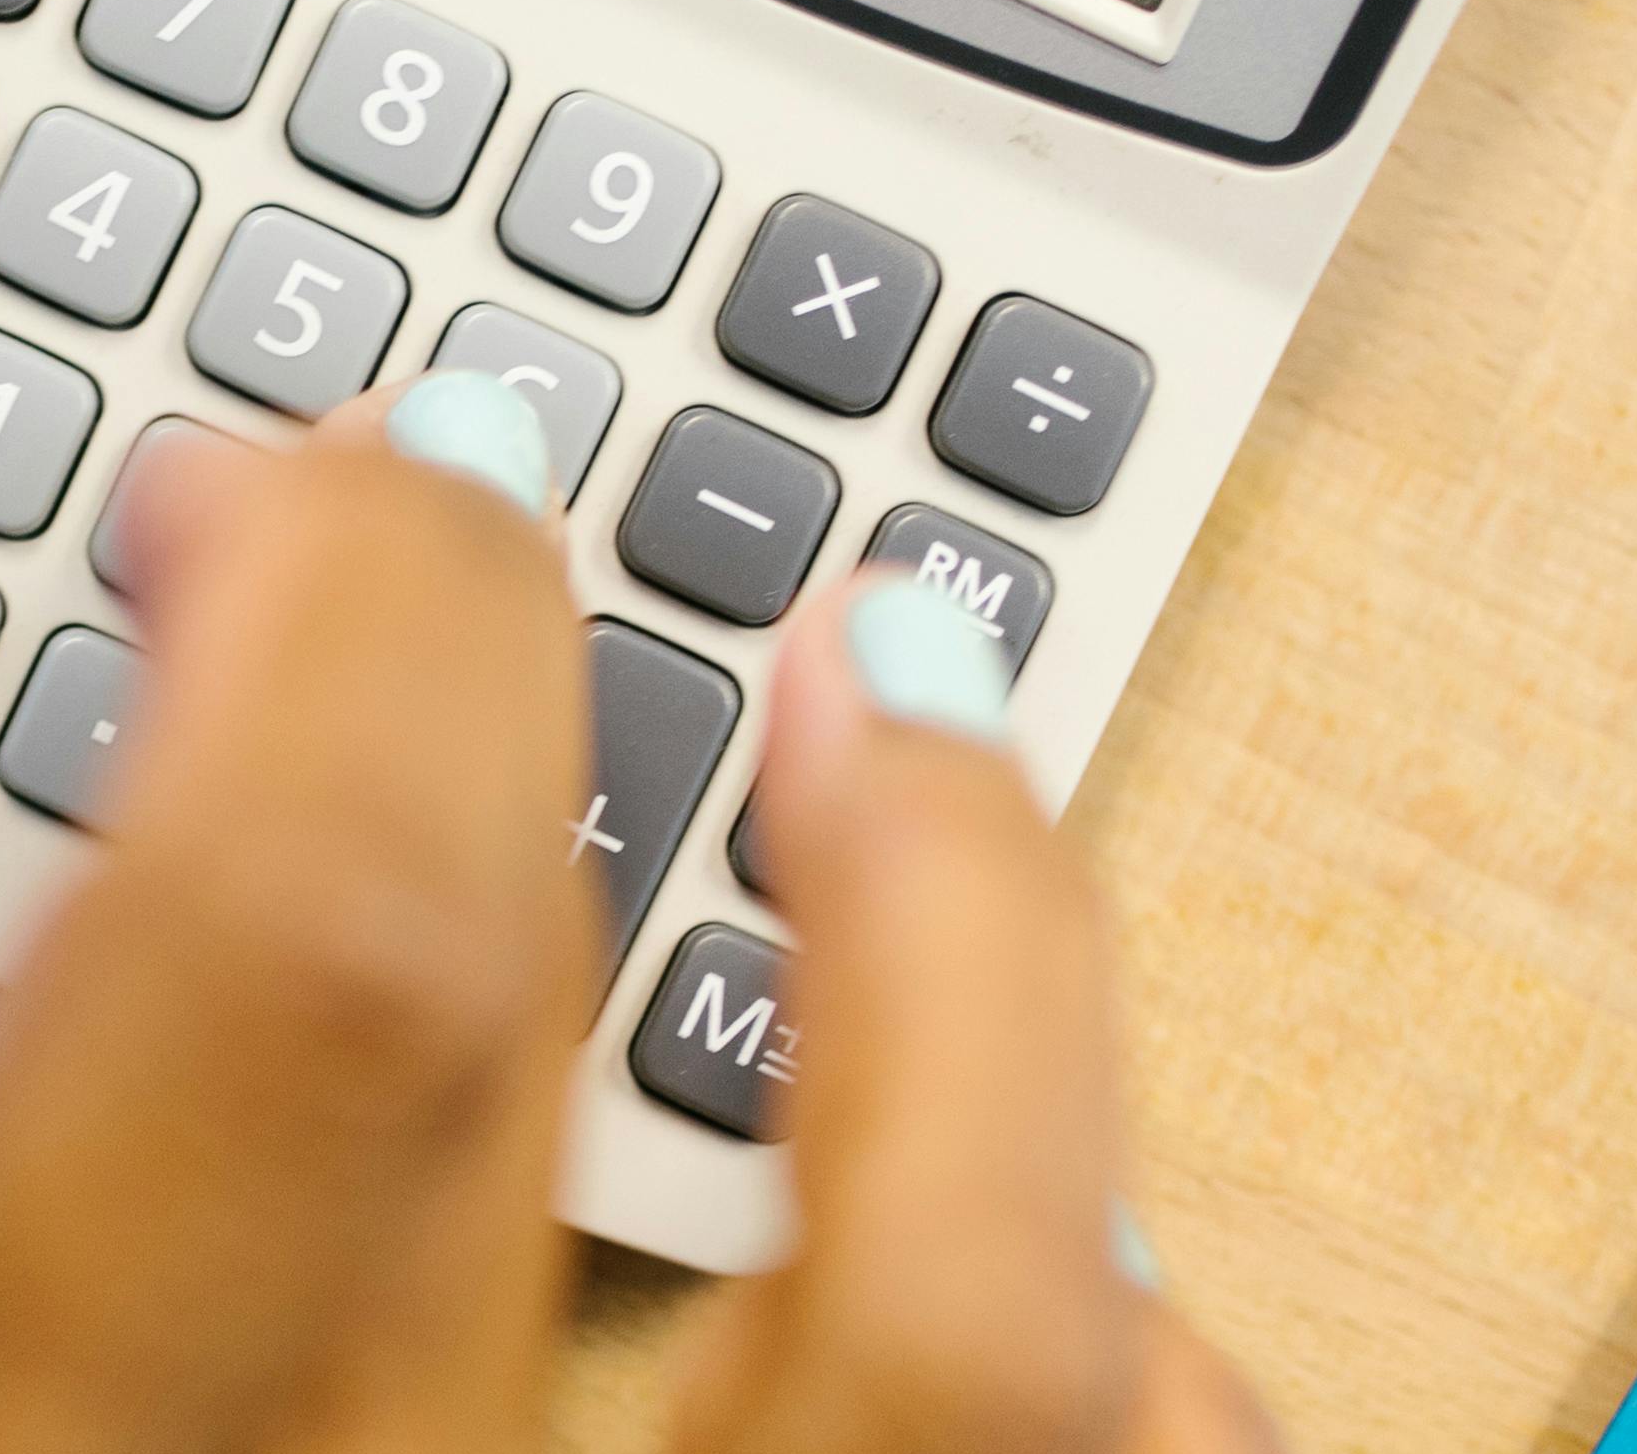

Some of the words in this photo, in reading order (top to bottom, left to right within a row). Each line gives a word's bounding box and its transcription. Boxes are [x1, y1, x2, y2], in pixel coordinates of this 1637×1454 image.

[361, 49, 444, 146] 8
[49, 171, 132, 262] 4
[571, 151, 653, 244] 9
[255, 259, 343, 357] 5
[914, 540, 1014, 621] RM
